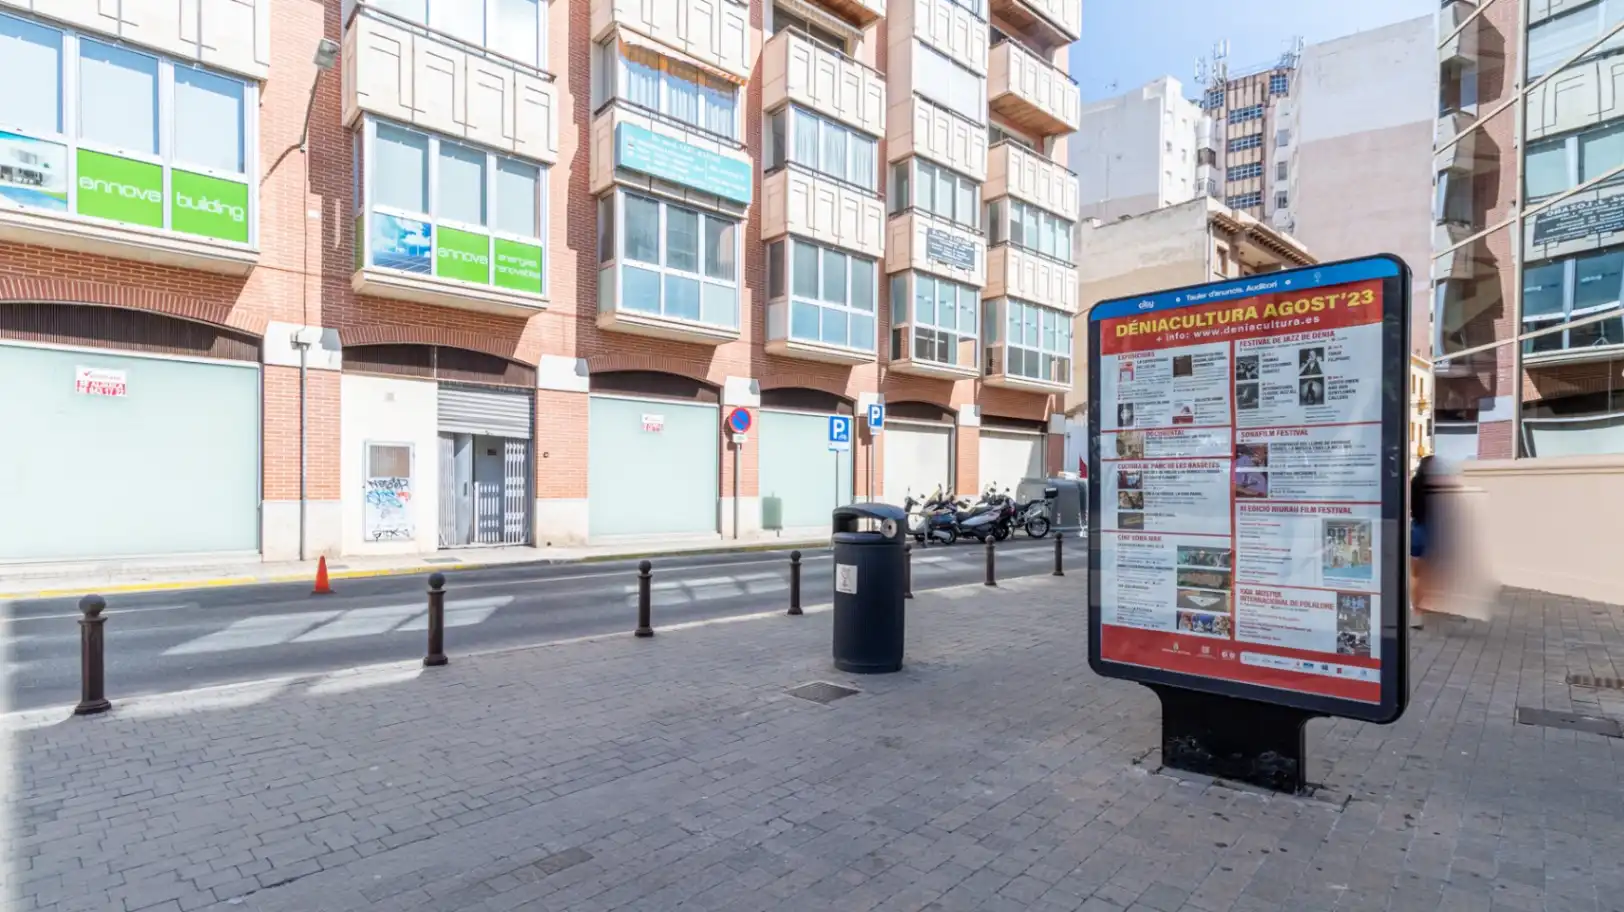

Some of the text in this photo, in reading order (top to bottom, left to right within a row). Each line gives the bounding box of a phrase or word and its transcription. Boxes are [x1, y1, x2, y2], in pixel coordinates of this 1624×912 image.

[176, 191, 245, 222] building
[1116, 302, 1258, 337] DÉNIACULTURA
[1165, 331, 1190, 342] info:
[1193, 315, 1320, 338] www.deniacultura.es
[1240, 338, 1271, 347] FESTIVAL
[871, 406, 881, 425] P
[833, 419, 845, 439] P
[1319, 506, 1352, 515] FESTIVAL
